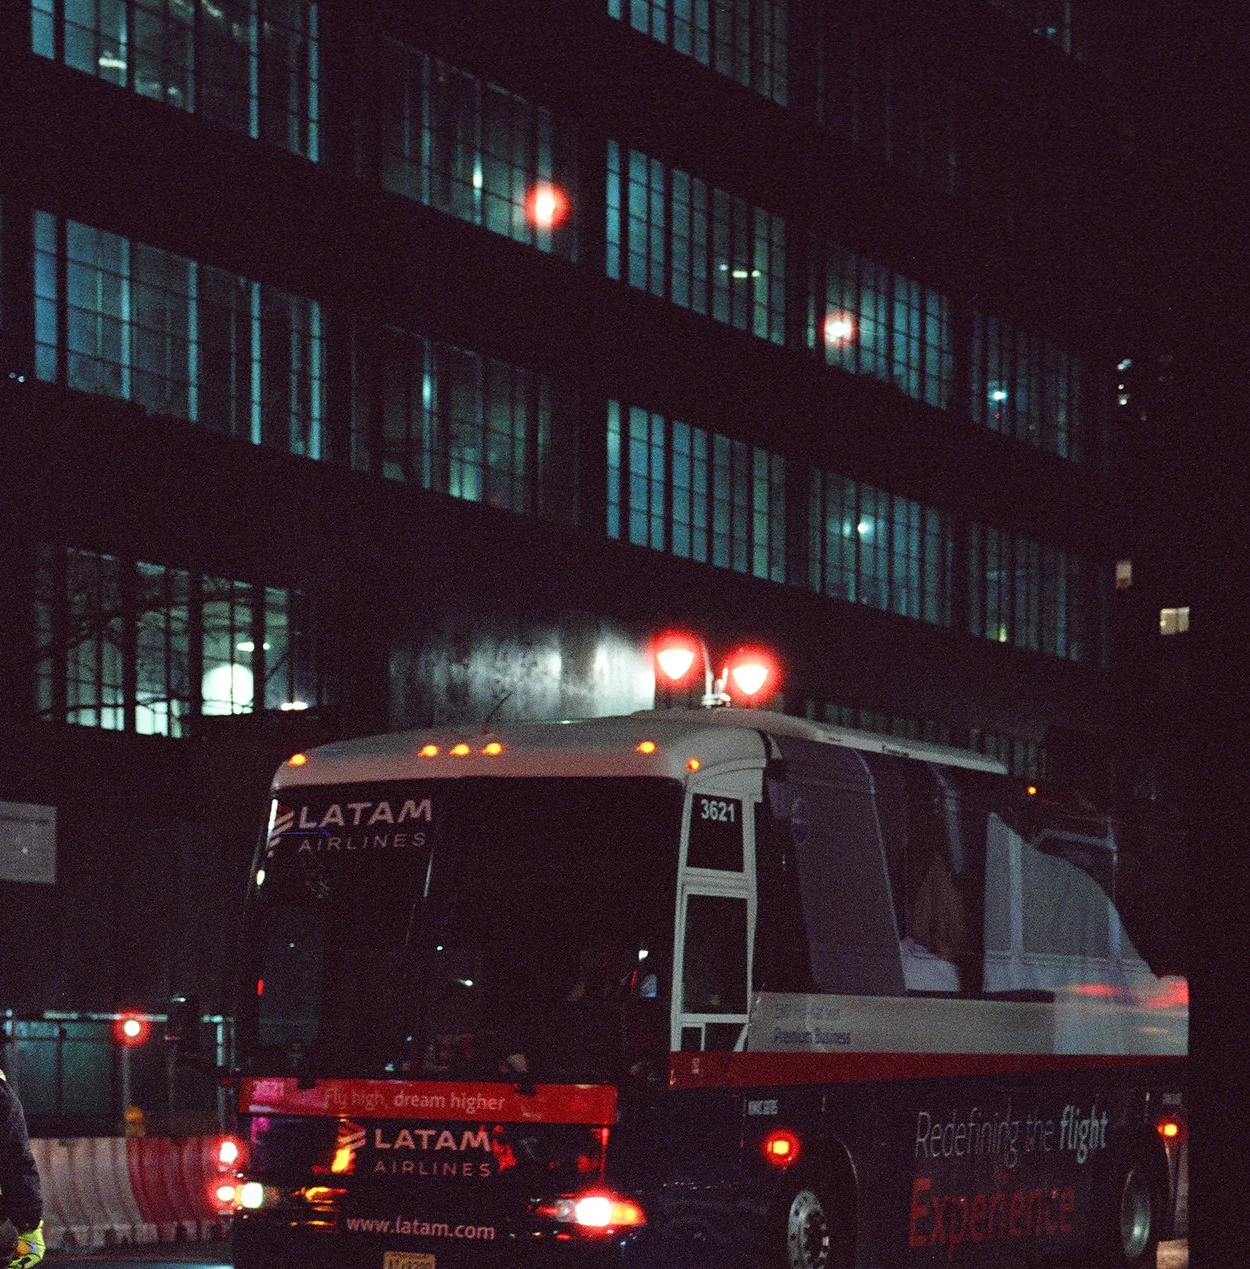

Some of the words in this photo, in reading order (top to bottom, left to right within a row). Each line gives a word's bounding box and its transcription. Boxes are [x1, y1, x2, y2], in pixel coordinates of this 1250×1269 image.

[299, 799, 432, 829] LATAM
[700, 798, 735, 822] 3621
[299, 832, 427, 851] AIRLINES
[393, 1089, 445, 1107] dream
[450, 1092, 506, 1115] higher
[374, 1128, 491, 1151] LATAM
[914, 1106, 1021, 1169] Redefining
[1024, 1106, 1055, 1153] the
[1059, 1103, 1110, 1165] flight
[373, 1160, 492, 1178] AIRLINES
[346, 1215, 495, 1240] www.latam.com
[908, 1172, 1076, 1262] Experience
